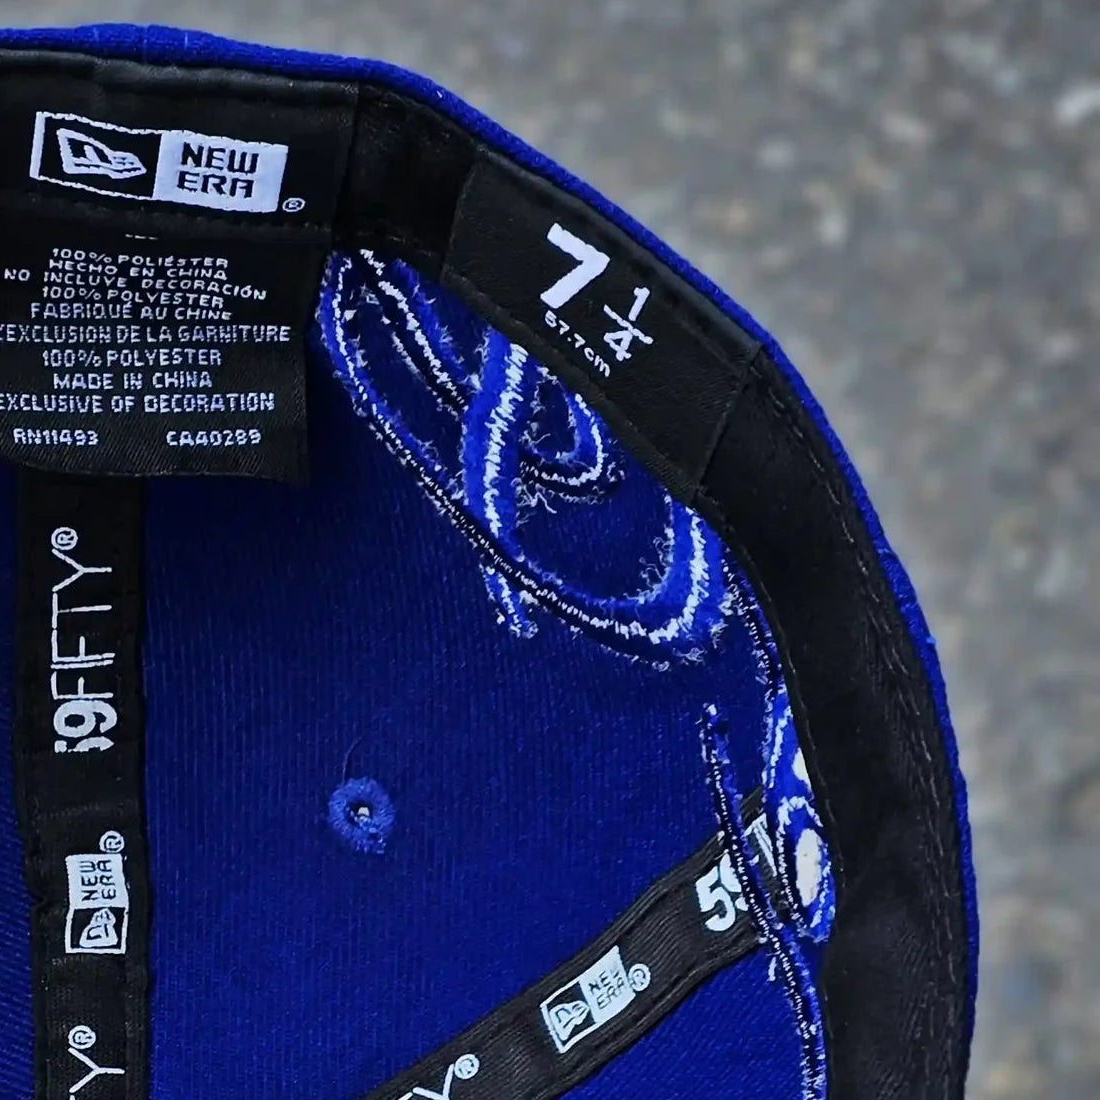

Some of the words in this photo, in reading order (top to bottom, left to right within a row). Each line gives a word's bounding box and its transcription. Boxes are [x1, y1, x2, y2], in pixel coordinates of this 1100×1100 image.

[180, 142, 260, 175] NEW
[177, 171, 255, 199] ERA
[53, 248, 112, 264] 100%
[540, 222, 611, 309] 7
[4, 269, 31, 281] NO
[43, 272, 127, 288] INCLUYE
[49, 259, 118, 275] HECHO
[130, 267, 154, 277] EN
[167, 269, 228, 281] CHINA
[42, 286, 101, 300] 100%
[107, 289, 224, 309] POLYESTER
[174, 308, 232, 321] CHINE
[117, 325, 141, 342] DE
[146, 325, 173, 343] LA
[177, 325, 291, 343] GARNITURE
[545, 310, 611, 378] 57.7cm
[42, 349, 101, 367] 100%
[107, 349, 222, 368] POLYESTER
[53, 372, 114, 390] MADE
[123, 372, 143, 390] IN
[152, 371, 213, 389] CHINA
[111, 396, 135, 412] OF
[144, 393, 275, 413] DECORATION
[79, 860, 99, 902] NEW
[97, 859, 117, 900] ERA
